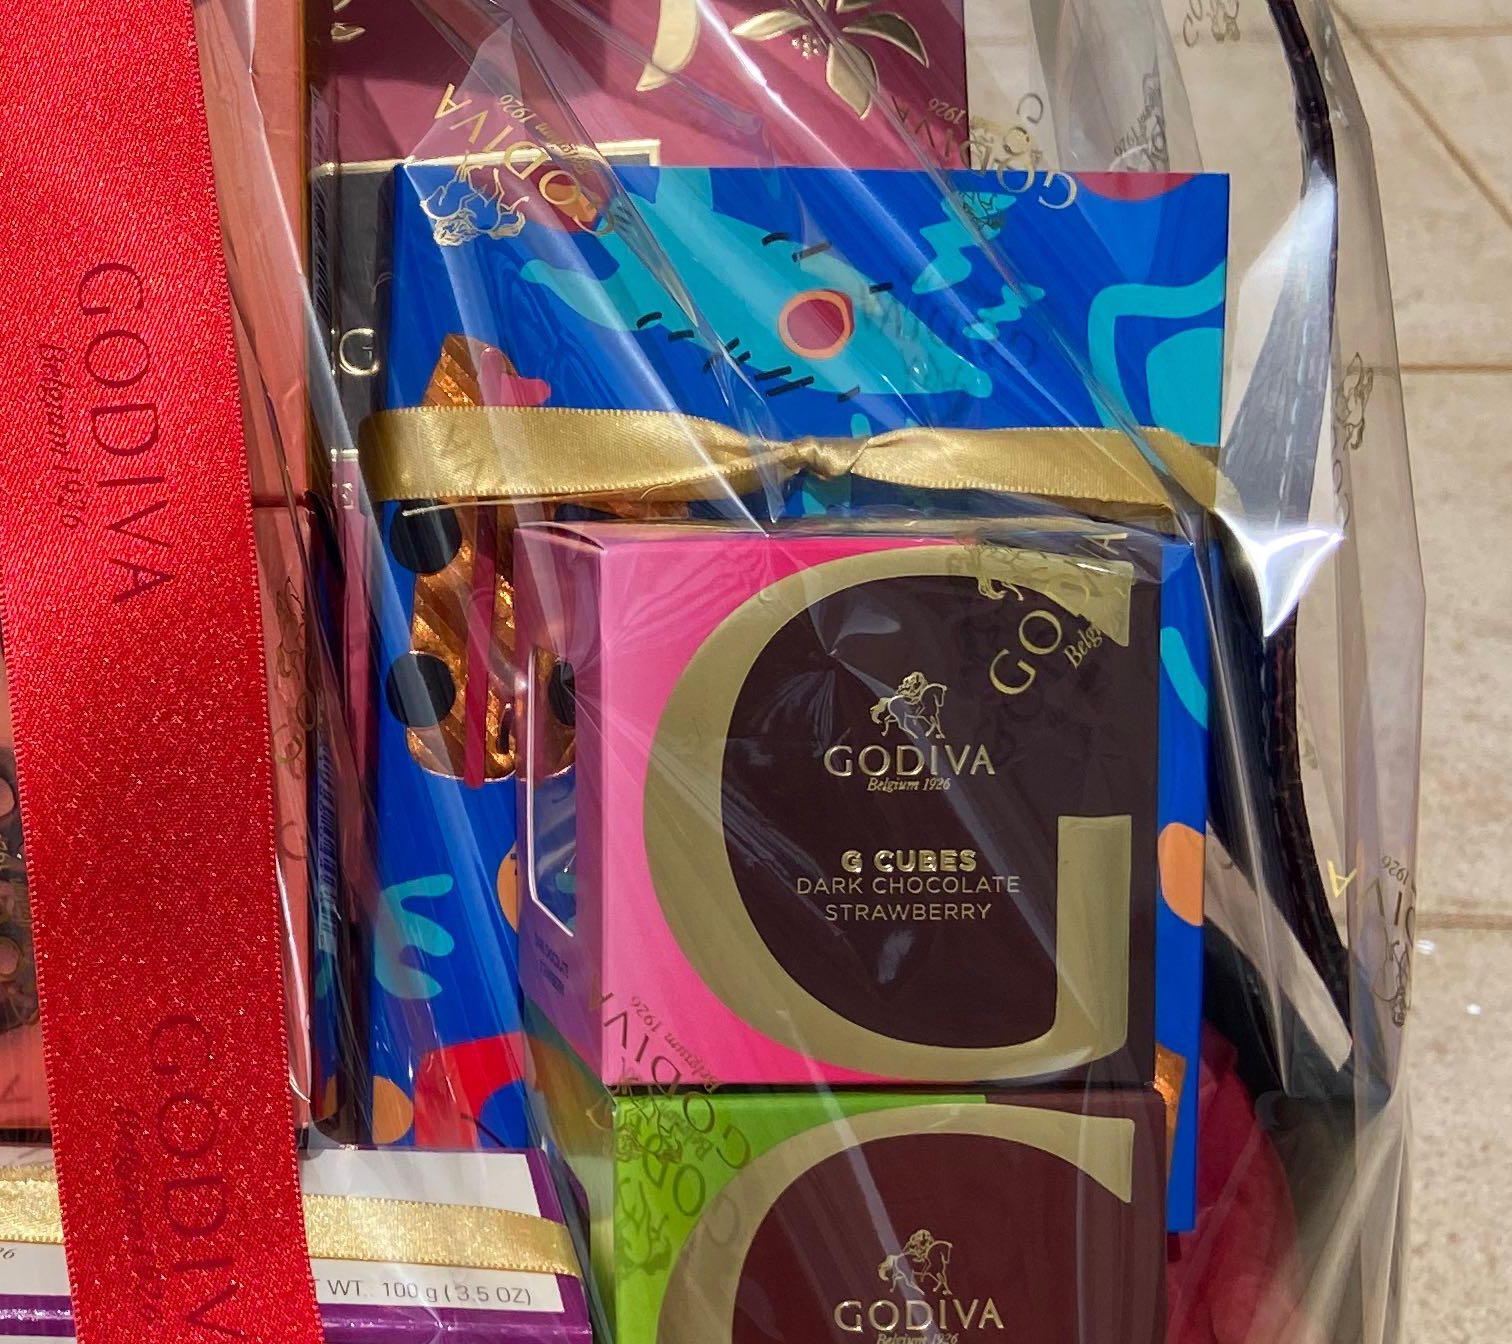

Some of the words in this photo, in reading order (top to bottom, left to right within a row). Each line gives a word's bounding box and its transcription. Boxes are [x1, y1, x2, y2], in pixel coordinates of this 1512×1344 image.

[77, 261, 175, 606] GODIVA
[824, 743, 996, 777] GODIVA
[867, 777, 920, 793] Belgium
[922, 777, 951, 792] 1926
[841, 849, 862, 873] G
[874, 849, 978, 873] CUBES
[796, 876, 864, 896] DARK
[871, 874, 1020, 895] CHOCOLATE
[825, 902, 993, 923] STRAWBERRY
[383, 1280, 417, 1299] 100
[497, 1285, 533, 1306] OZ)
[834, 1299, 1005, 1331] GODIVA
